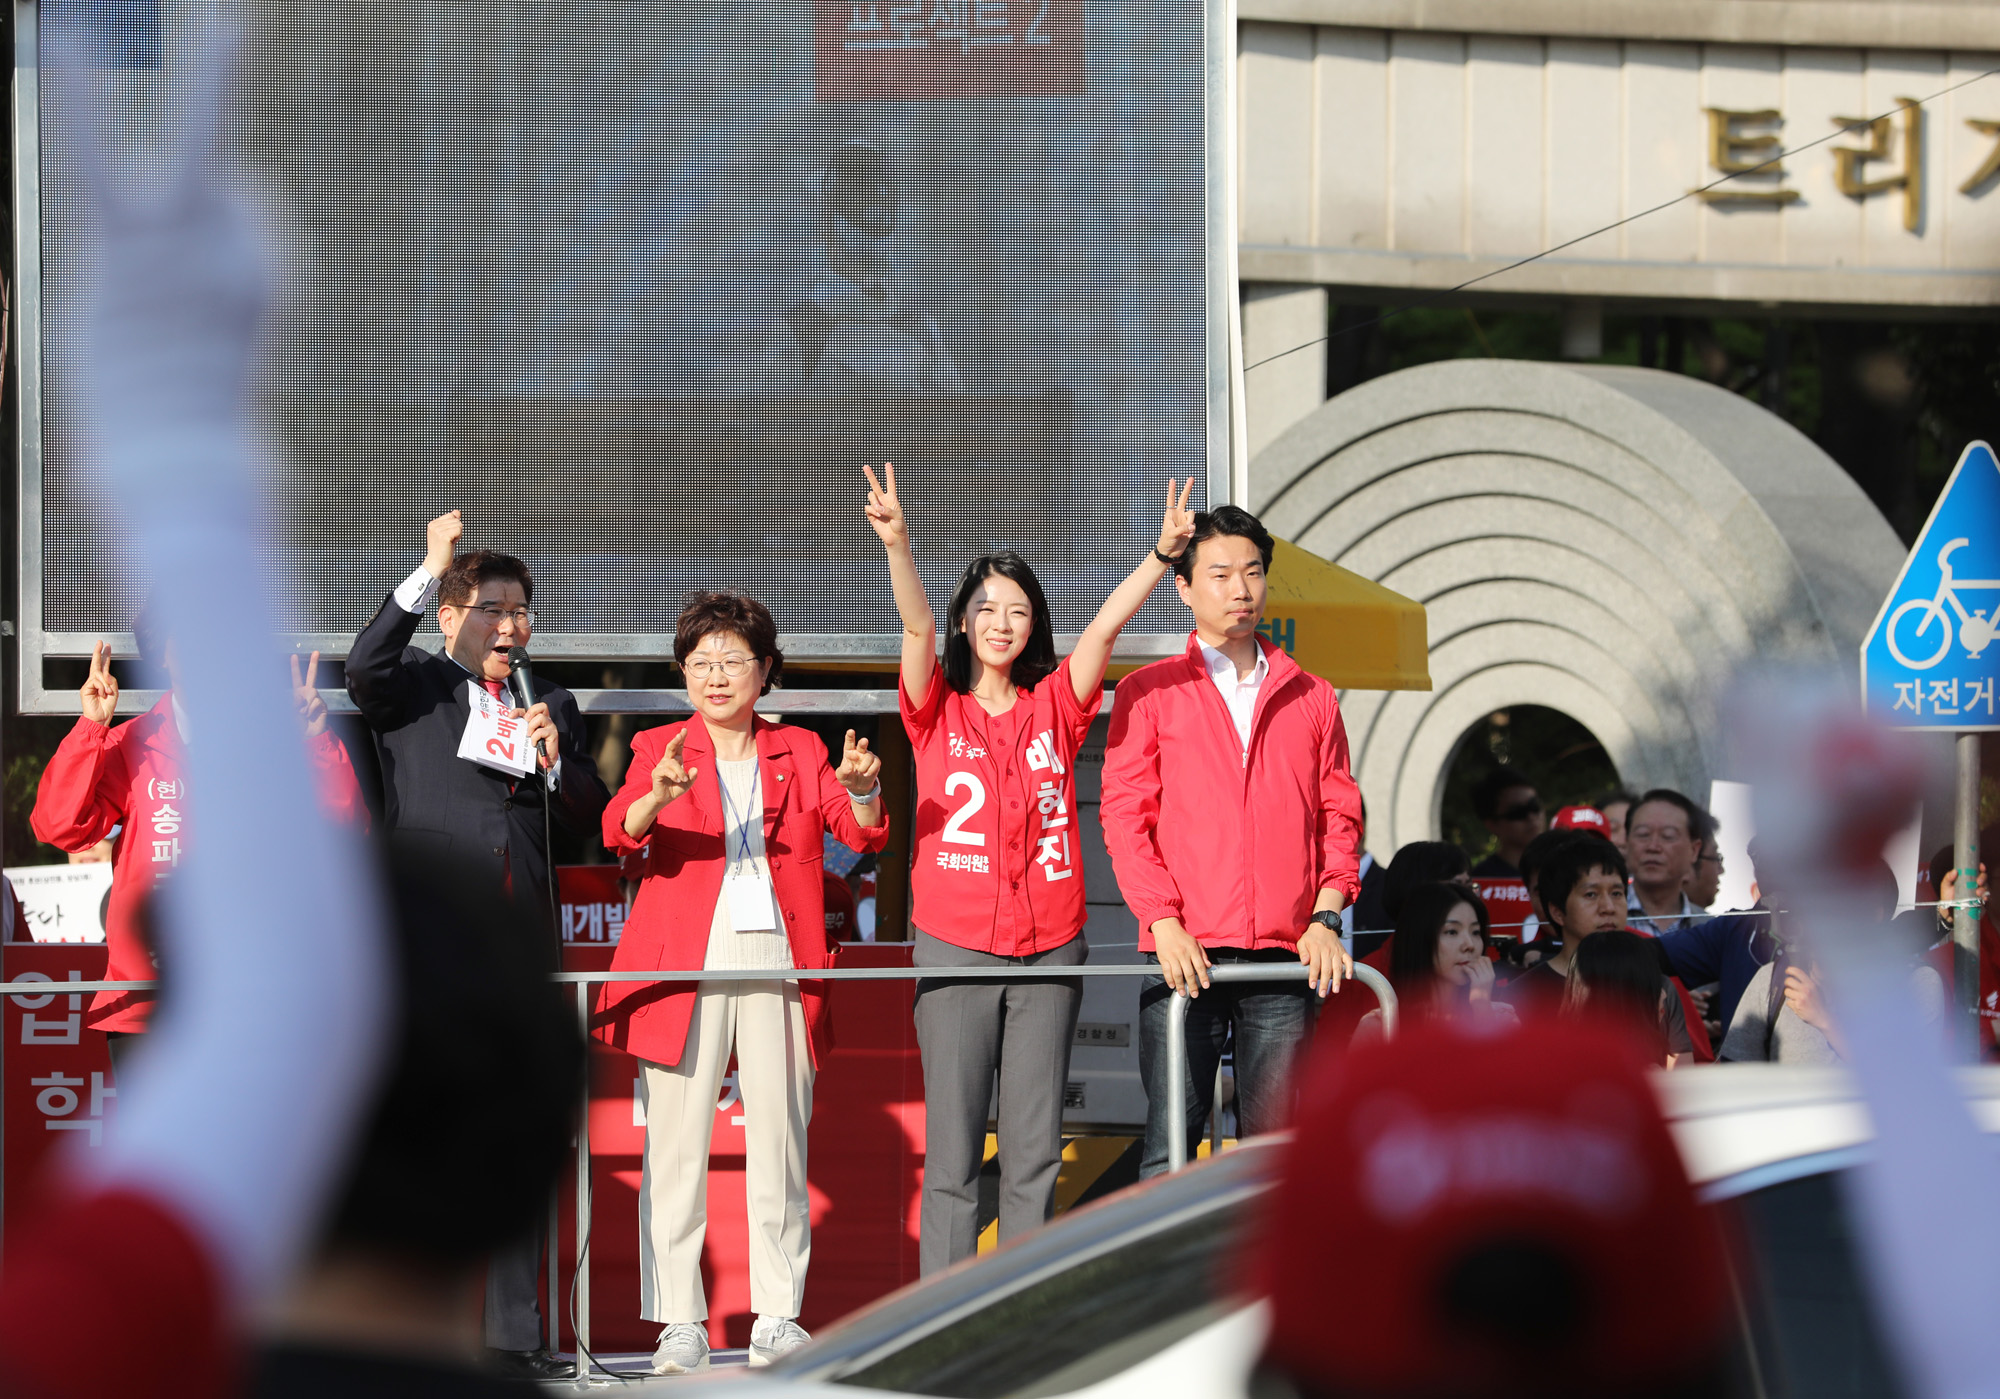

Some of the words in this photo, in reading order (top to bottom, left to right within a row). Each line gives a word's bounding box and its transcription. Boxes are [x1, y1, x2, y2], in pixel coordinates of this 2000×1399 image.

[1892, 677, 1994, 715] 자전거
[486, 738, 515, 761] 2
[147, 777, 185, 800] (현)
[1025, 729, 1073, 882] 배현진
[941, 771, 986, 847] 2
